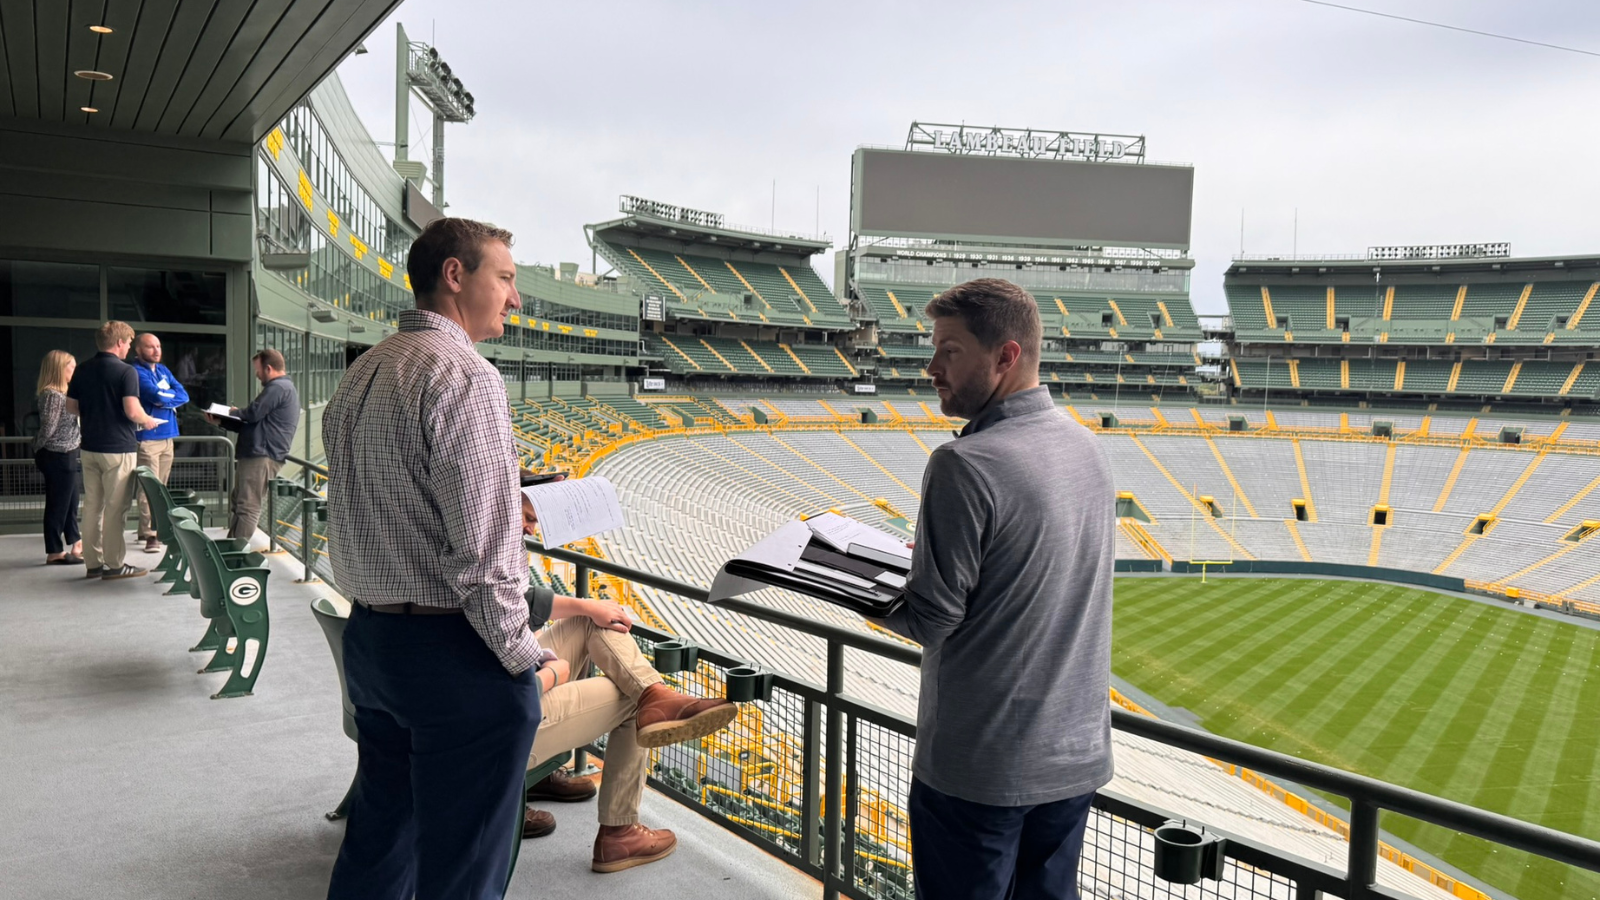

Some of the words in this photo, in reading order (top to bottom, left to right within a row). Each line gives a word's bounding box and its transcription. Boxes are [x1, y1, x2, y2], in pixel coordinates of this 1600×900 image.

[934, 130, 1047, 155] LAMBEAU
[1059, 137, 1126, 159] FIELD
[915, 250, 947, 258] CHAMPIONS
